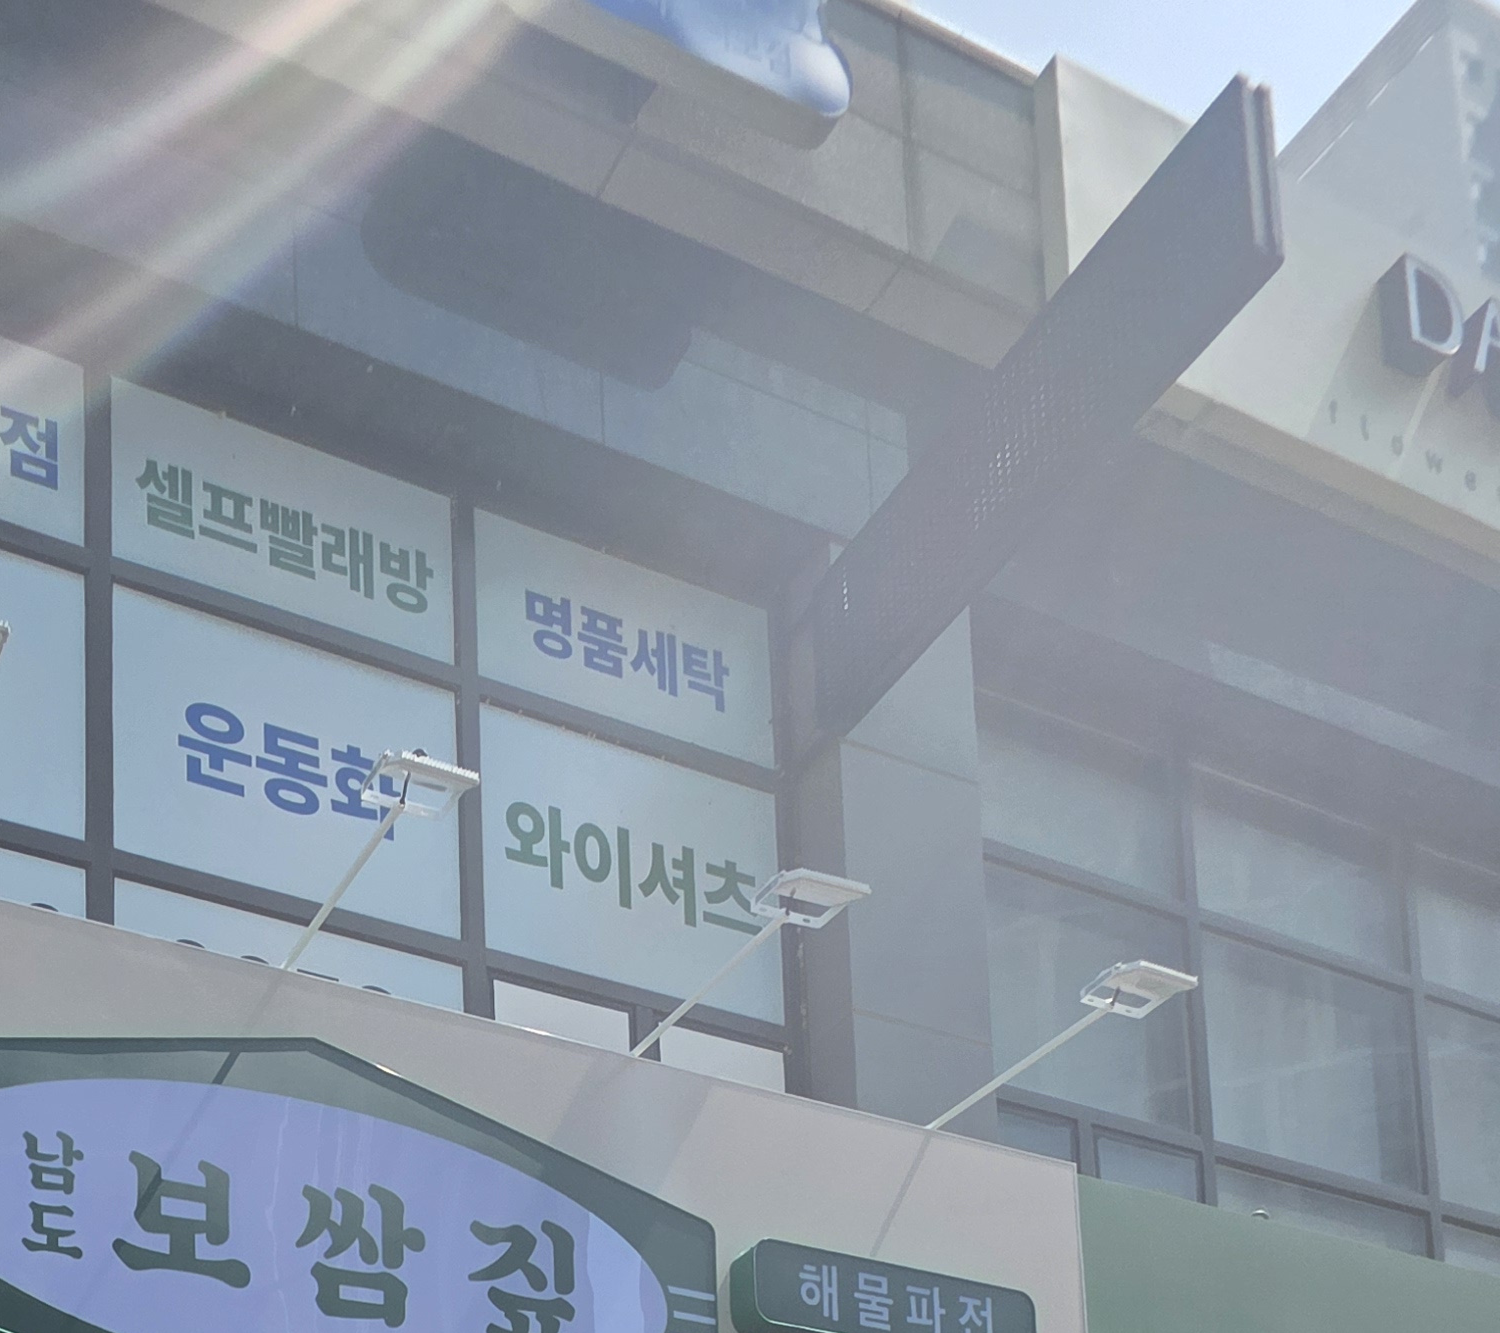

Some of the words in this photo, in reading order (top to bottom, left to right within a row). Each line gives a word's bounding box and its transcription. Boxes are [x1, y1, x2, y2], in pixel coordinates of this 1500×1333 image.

[135, 457, 435, 615] 셀프빨래방
[524, 588, 731, 713] 명품세탁
[177, 701, 403, 842] 운동화
[504, 800, 769, 936] 와이셔츠
[21, 1130, 85, 1261] 남도
